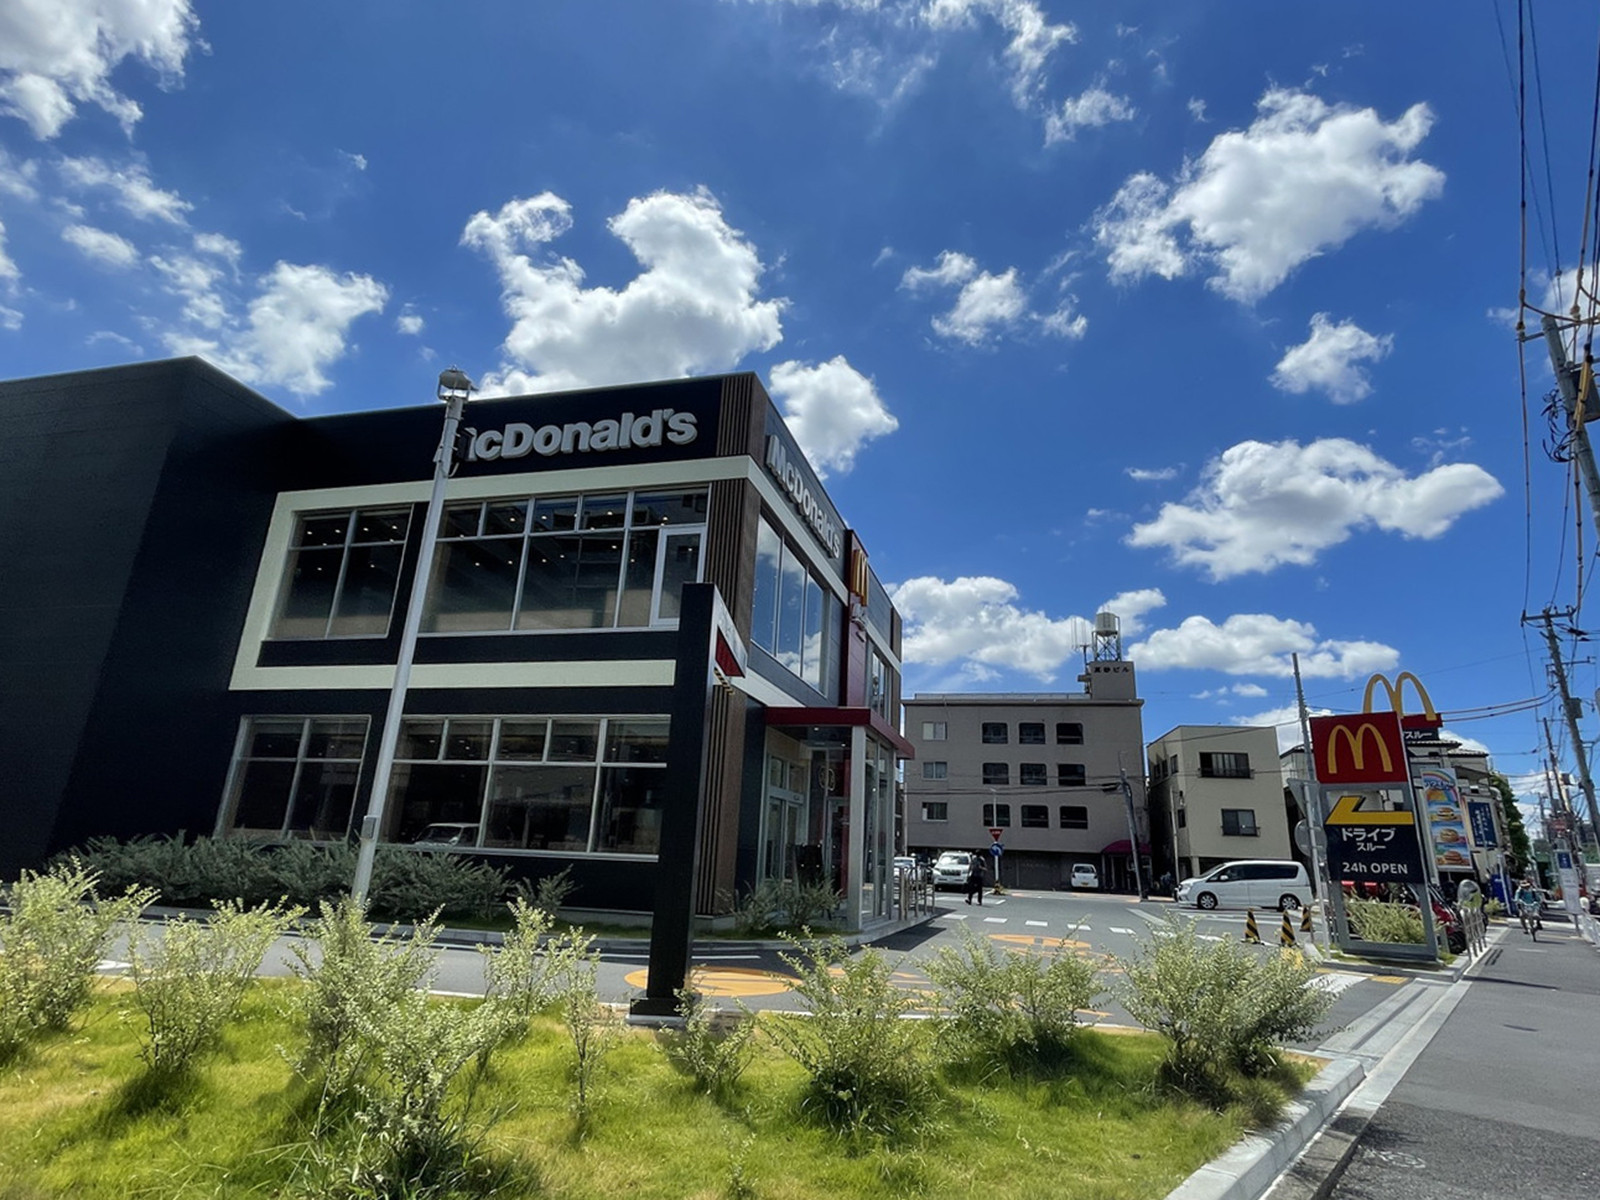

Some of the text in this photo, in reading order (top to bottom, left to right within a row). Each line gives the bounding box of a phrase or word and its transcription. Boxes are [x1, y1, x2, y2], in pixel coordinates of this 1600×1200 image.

[1341, 827, 1396, 842] ドライブ
[1356, 842, 1387, 852] スルー
[1342, 862, 1408, 875] 24h OPEN
